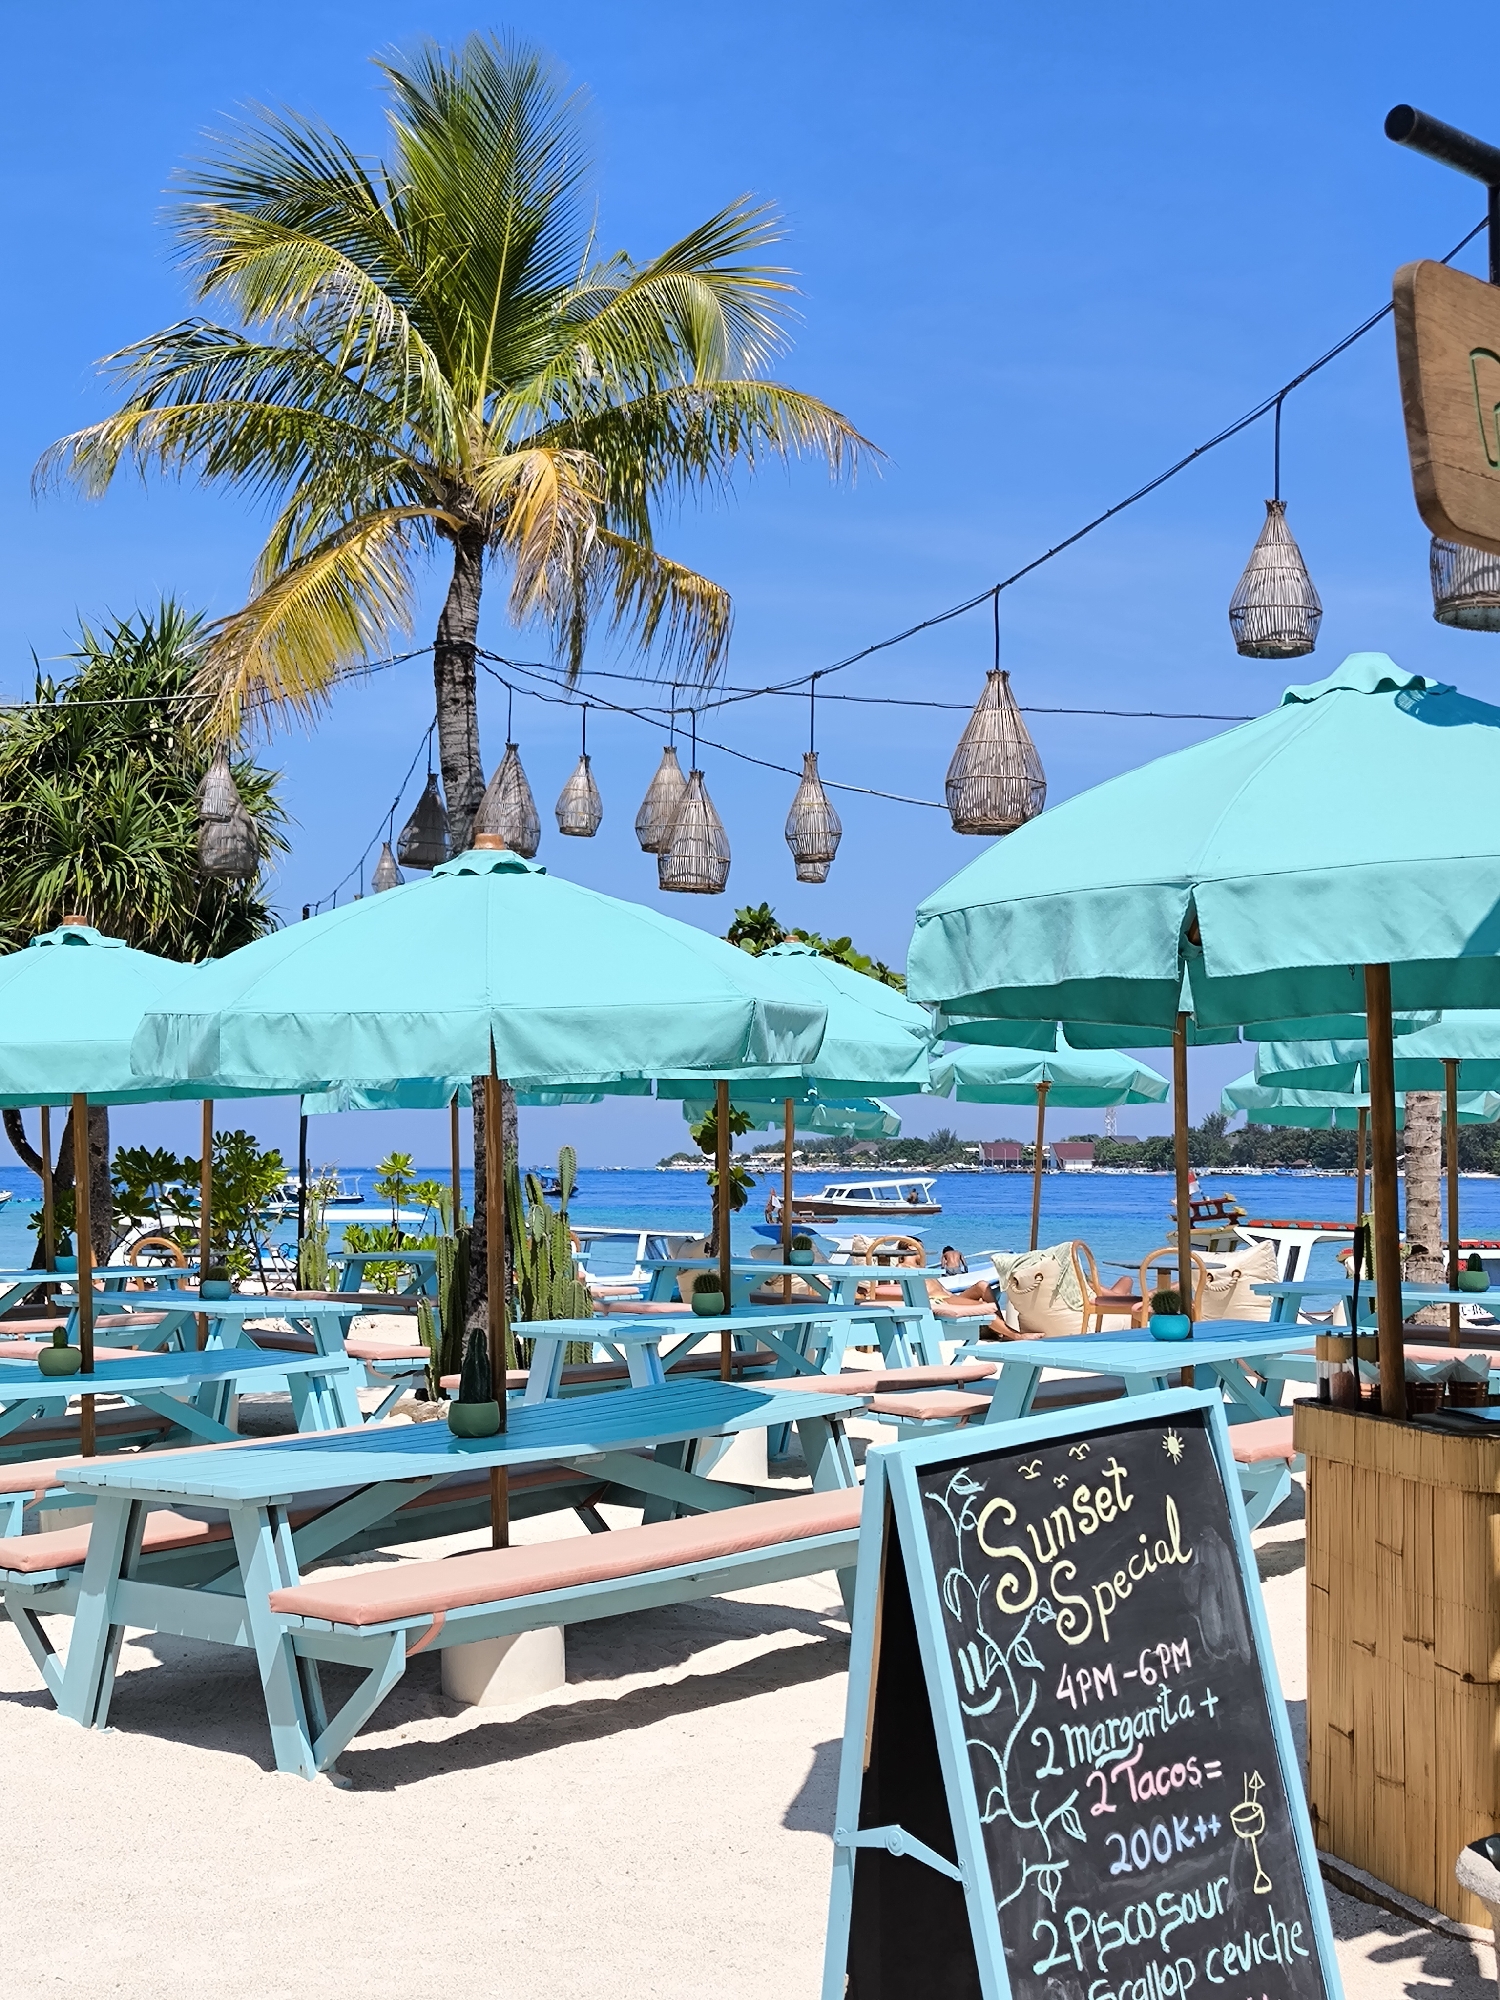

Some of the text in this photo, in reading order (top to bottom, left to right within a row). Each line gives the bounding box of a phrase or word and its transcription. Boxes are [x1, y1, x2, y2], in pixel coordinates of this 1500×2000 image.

[977, 1457, 1134, 1614] Sunset
[1050, 1495, 1193, 1645] Special
[1031, 1727, 1064, 1779] 2
[1060, 1683, 1195, 1769] margarita
[1086, 1770, 1117, 1817] 2
[1205, 1904, 1310, 1984] ceviche
